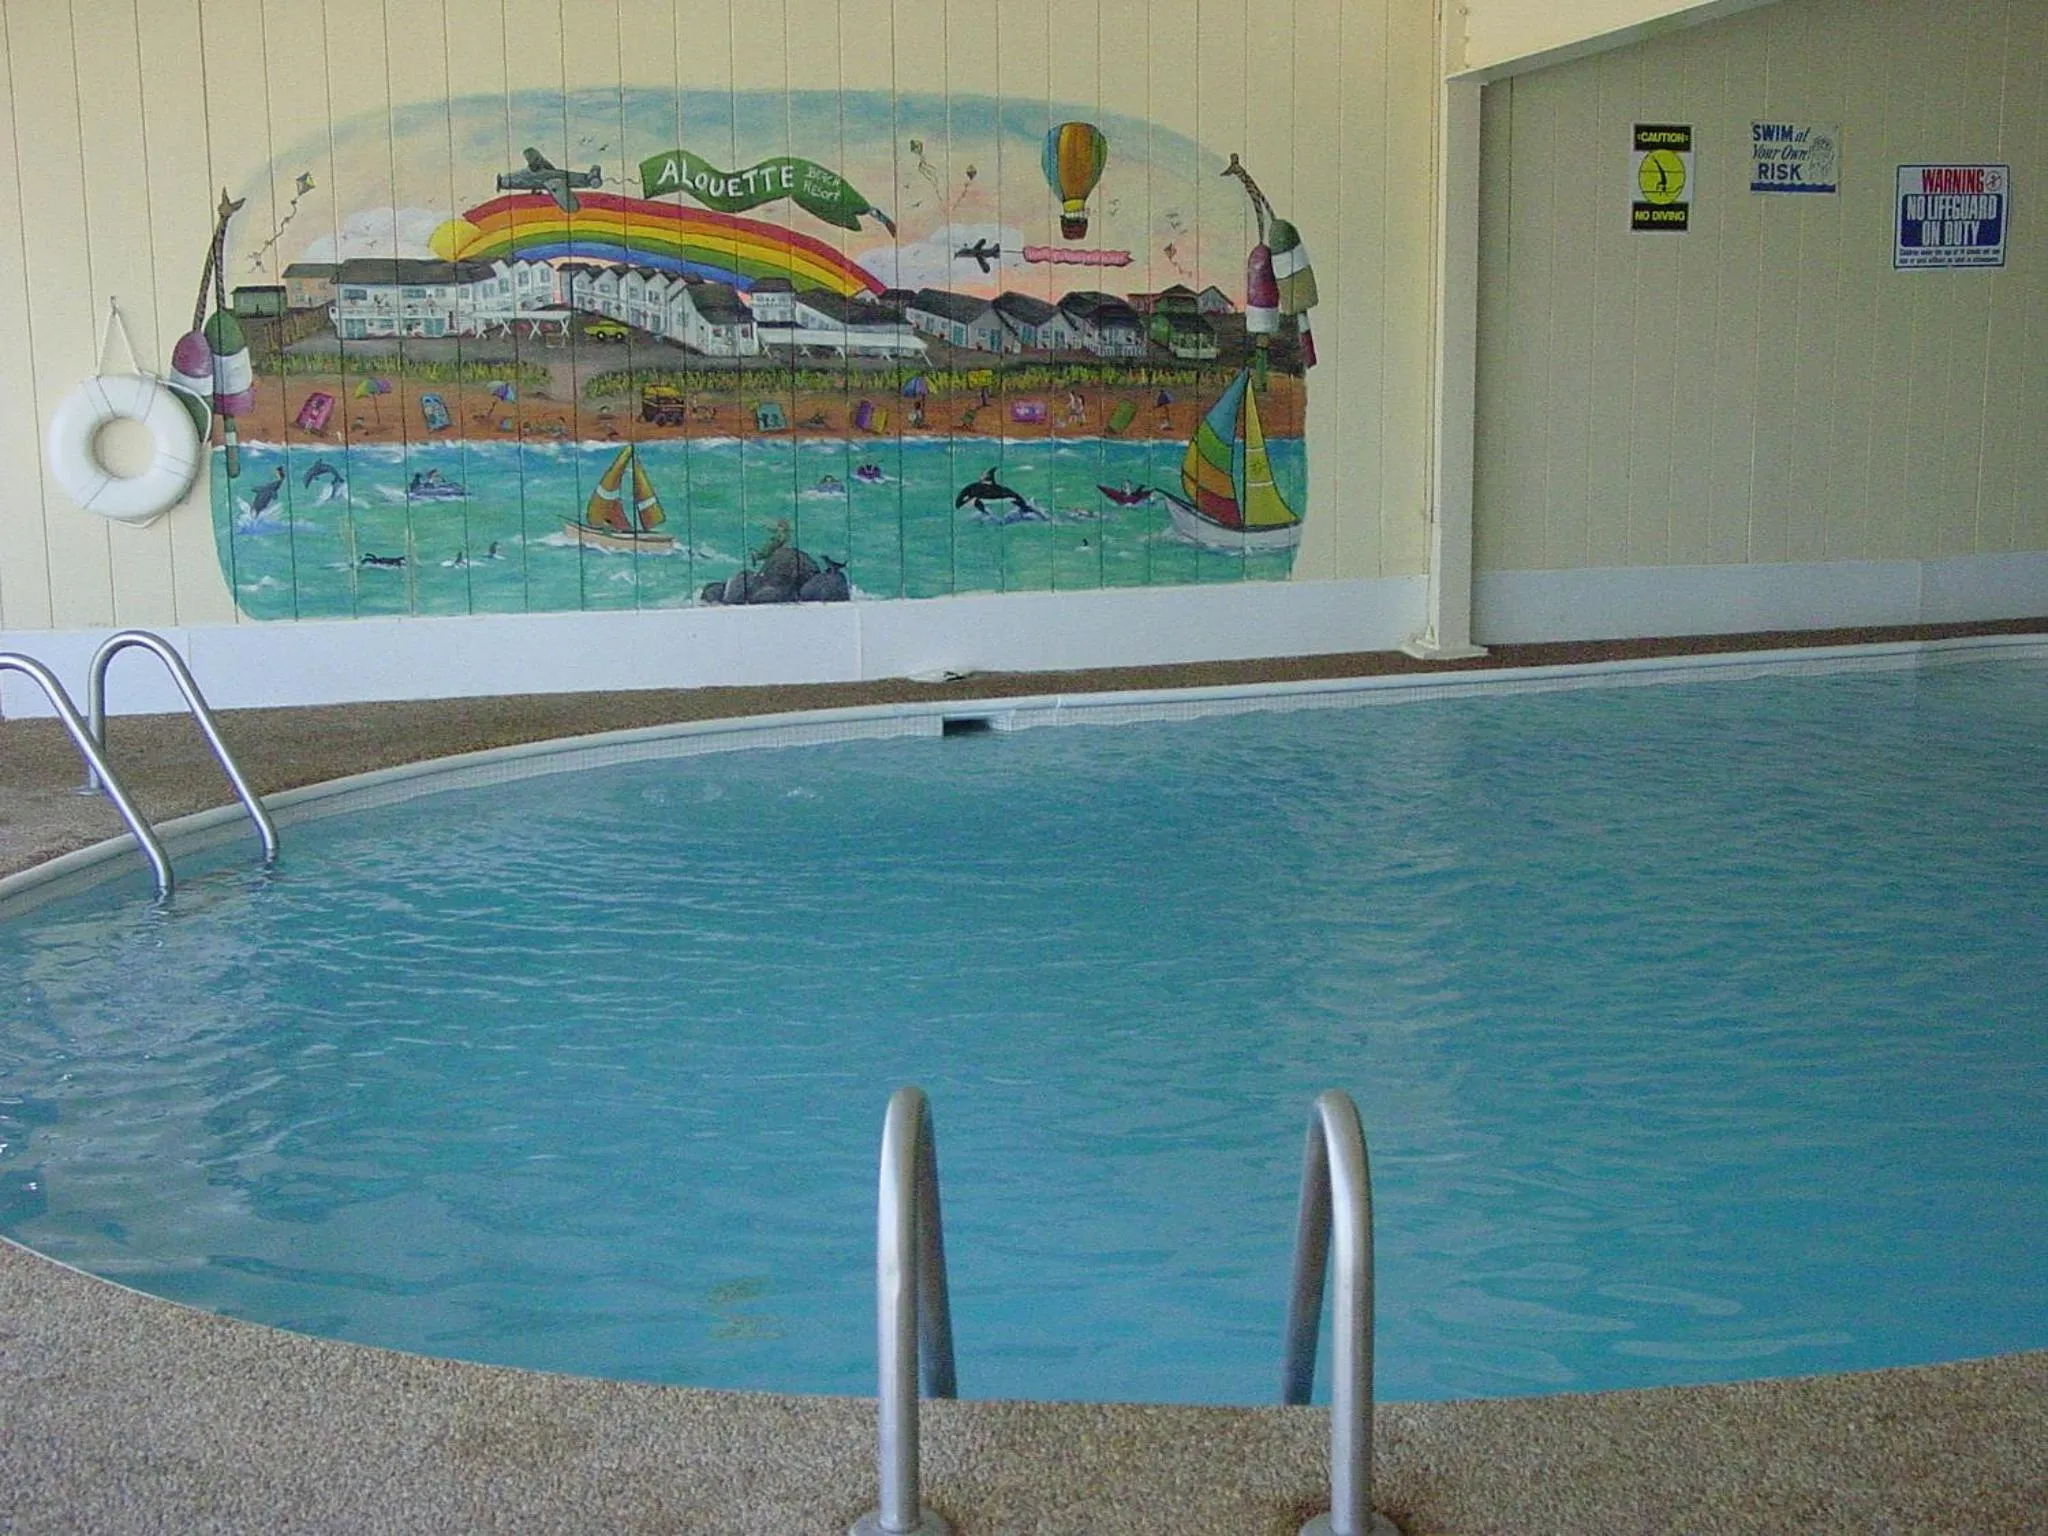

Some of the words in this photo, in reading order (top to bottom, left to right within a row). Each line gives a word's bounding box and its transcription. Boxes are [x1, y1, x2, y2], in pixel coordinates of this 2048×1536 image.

[1641, 132, 1685, 143] CAUTION
[1752, 124, 1793, 142] SWIM
[1752, 143, 1780, 160] Your
[1781, 144, 1808, 160] Own
[1758, 163, 1802, 181] RISK
[1922, 168, 1985, 193] WARNING
[1635, 210, 1649, 220] NO
[1652, 210, 1685, 221] DIVING
[1907, 195, 1926, 220] NO
[1927, 194, 1997, 220] LIFEGUARD
[1922, 221, 1940, 246] ON
[1944, 220, 1980, 246] DUTY
